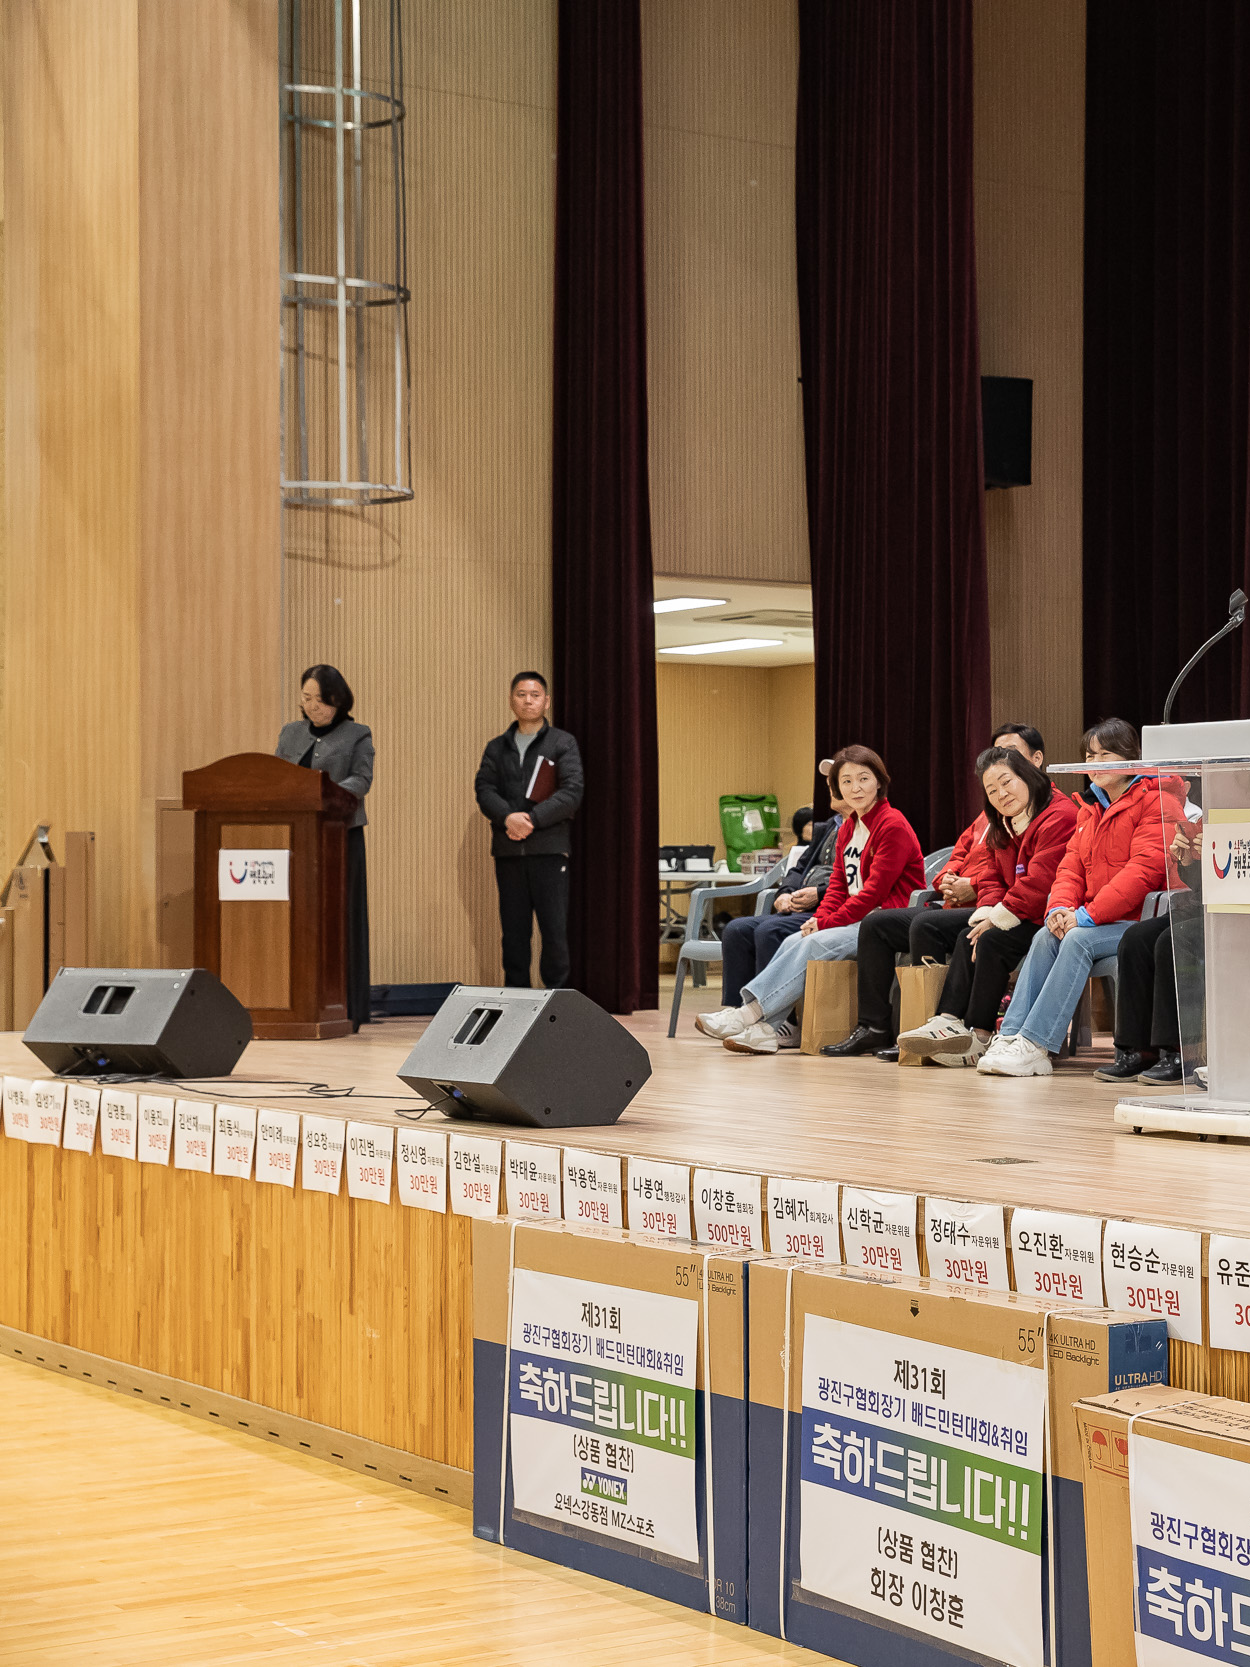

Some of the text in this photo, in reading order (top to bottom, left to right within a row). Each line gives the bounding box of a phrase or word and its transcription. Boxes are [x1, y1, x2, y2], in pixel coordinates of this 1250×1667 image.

[351, 1138, 374, 1157] 이진범
[402, 1145, 426, 1165] 정신영
[269, 1153, 291, 1170] 30만원
[314, 1160, 336, 1178] 30만원
[510, 1160, 537, 1181] 박태윤
[360, 1167, 384, 1186] 30만원
[410, 1175, 437, 1194] 30만원
[568, 1167, 617, 1194] 박용현 자문위원
[634, 1177, 663, 1200] 나봉연
[464, 1183, 491, 1203] 30만원
[520, 1192, 550, 1213] 30만원
[702, 1188, 735, 1212] 이창훈
[577, 1200, 609, 1224] 30만원
[774, 1198, 833, 1224] 김혜자 회계감사
[847, 1208, 910, 1237] 신학균 자문위원
[641, 1212, 676, 1236] 30만원
[706, 1224, 751, 1249] 500만원
[931, 1219, 999, 1248] 정태수 자문위원
[785, 1234, 824, 1259] 30만원
[1019, 1232, 1094, 1263] 오진환 자문위원
[862, 1246, 902, 1273] 30만원
[1111, 1242, 1193, 1278] 현승순 자문위원
[725, 1272, 734, 1282] HD
[945, 1259, 988, 1286] 30만원
[712, 1284, 736, 1296] Backlight
[1035, 1272, 1083, 1301] 30만원
[1128, 1287, 1180, 1316] 30만원
[581, 1301, 622, 1334] 제31회
[522, 1322, 684, 1377] 광진구협회장기 배드민턴대회&취임
[1060, 1334, 1083, 1347] ULTRA
[1085, 1339, 1096, 1351] HD
[1048, 1347, 1100, 1367] LED Backlight
[893, 1359, 947, 1400] 제31회
[1114, 1370, 1162, 1386] ULTRA HD
[518, 1361, 688, 1449] 축하드립니다!!
[817, 1376, 906, 1424] 광진구협회장기
[911, 1402, 1029, 1457] 배드민턴대회&취임
[598, 1476, 626, 1501] YONEX
[811, 1422, 1030, 1541] 축하드립니다!!
[554, 1492, 655, 1539] 요넥스강동점 MZ스포츠
[869, 1566, 964, 1630] 회장 이창훈
